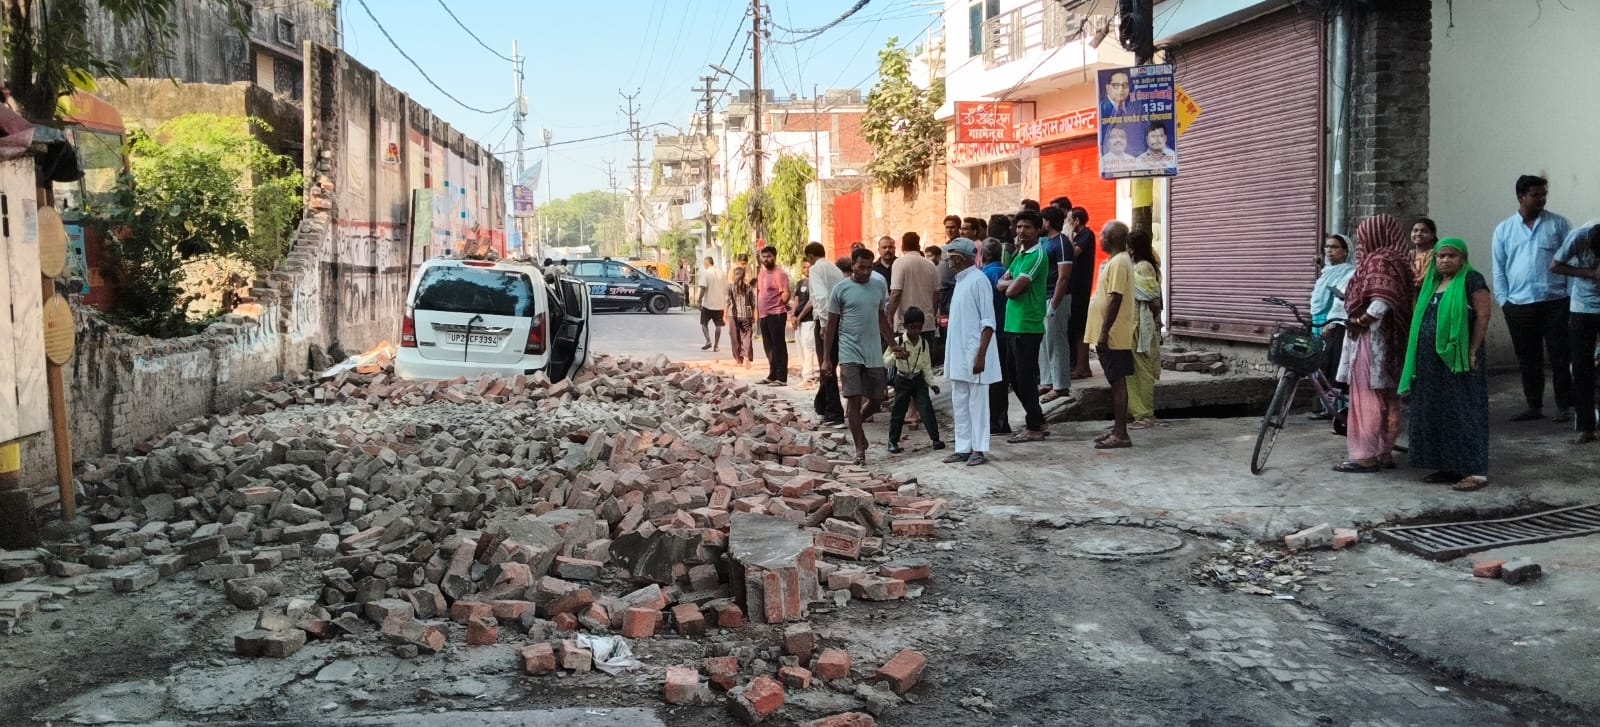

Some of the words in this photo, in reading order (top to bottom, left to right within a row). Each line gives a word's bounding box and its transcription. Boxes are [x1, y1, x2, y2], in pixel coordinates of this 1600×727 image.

[1143, 102, 1164, 112] 135
[609, 286, 637, 295] पुलिस
[451, 333, 498, 345] UP2CF3394
